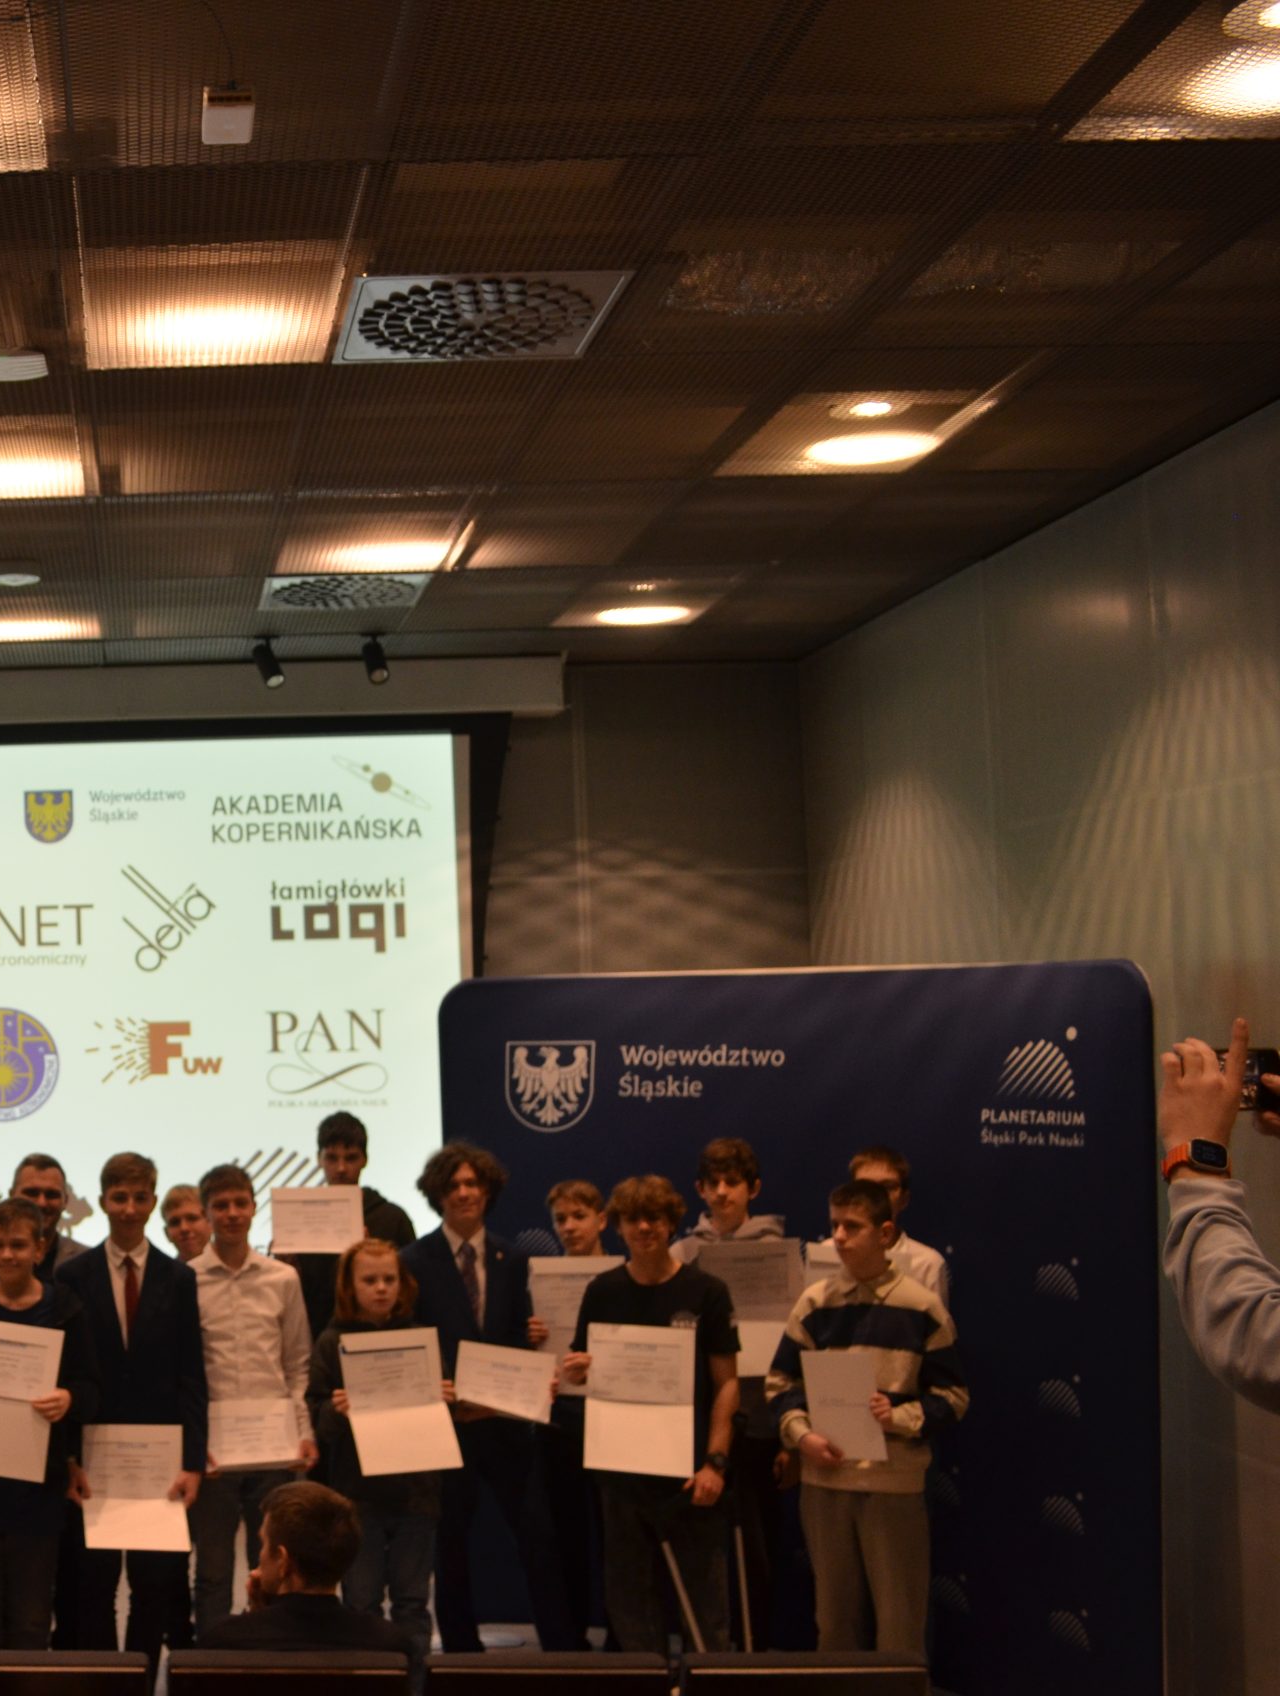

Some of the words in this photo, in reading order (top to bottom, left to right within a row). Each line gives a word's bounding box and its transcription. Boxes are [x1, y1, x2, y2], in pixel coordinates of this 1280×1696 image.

[89, 788, 186, 804] Województwo
[212, 793, 343, 816] AKADEMIA
[89, 807, 139, 823] Śląskie
[211, 814, 423, 844] KOPERNIKAŃSKA
[271, 877, 405, 903] łamigłówki
[266, 1008, 384, 1054] PAN
[620, 1044, 786, 1071] Województwo
[618, 1071, 704, 1103] Śląskie
[980, 1108, 1086, 1126] PLANETARIUM
[980, 1126, 1016, 1147] Śląski
[1018, 1130, 1045, 1146] Park
[1048, 1132, 1085, 1147] Nauki
